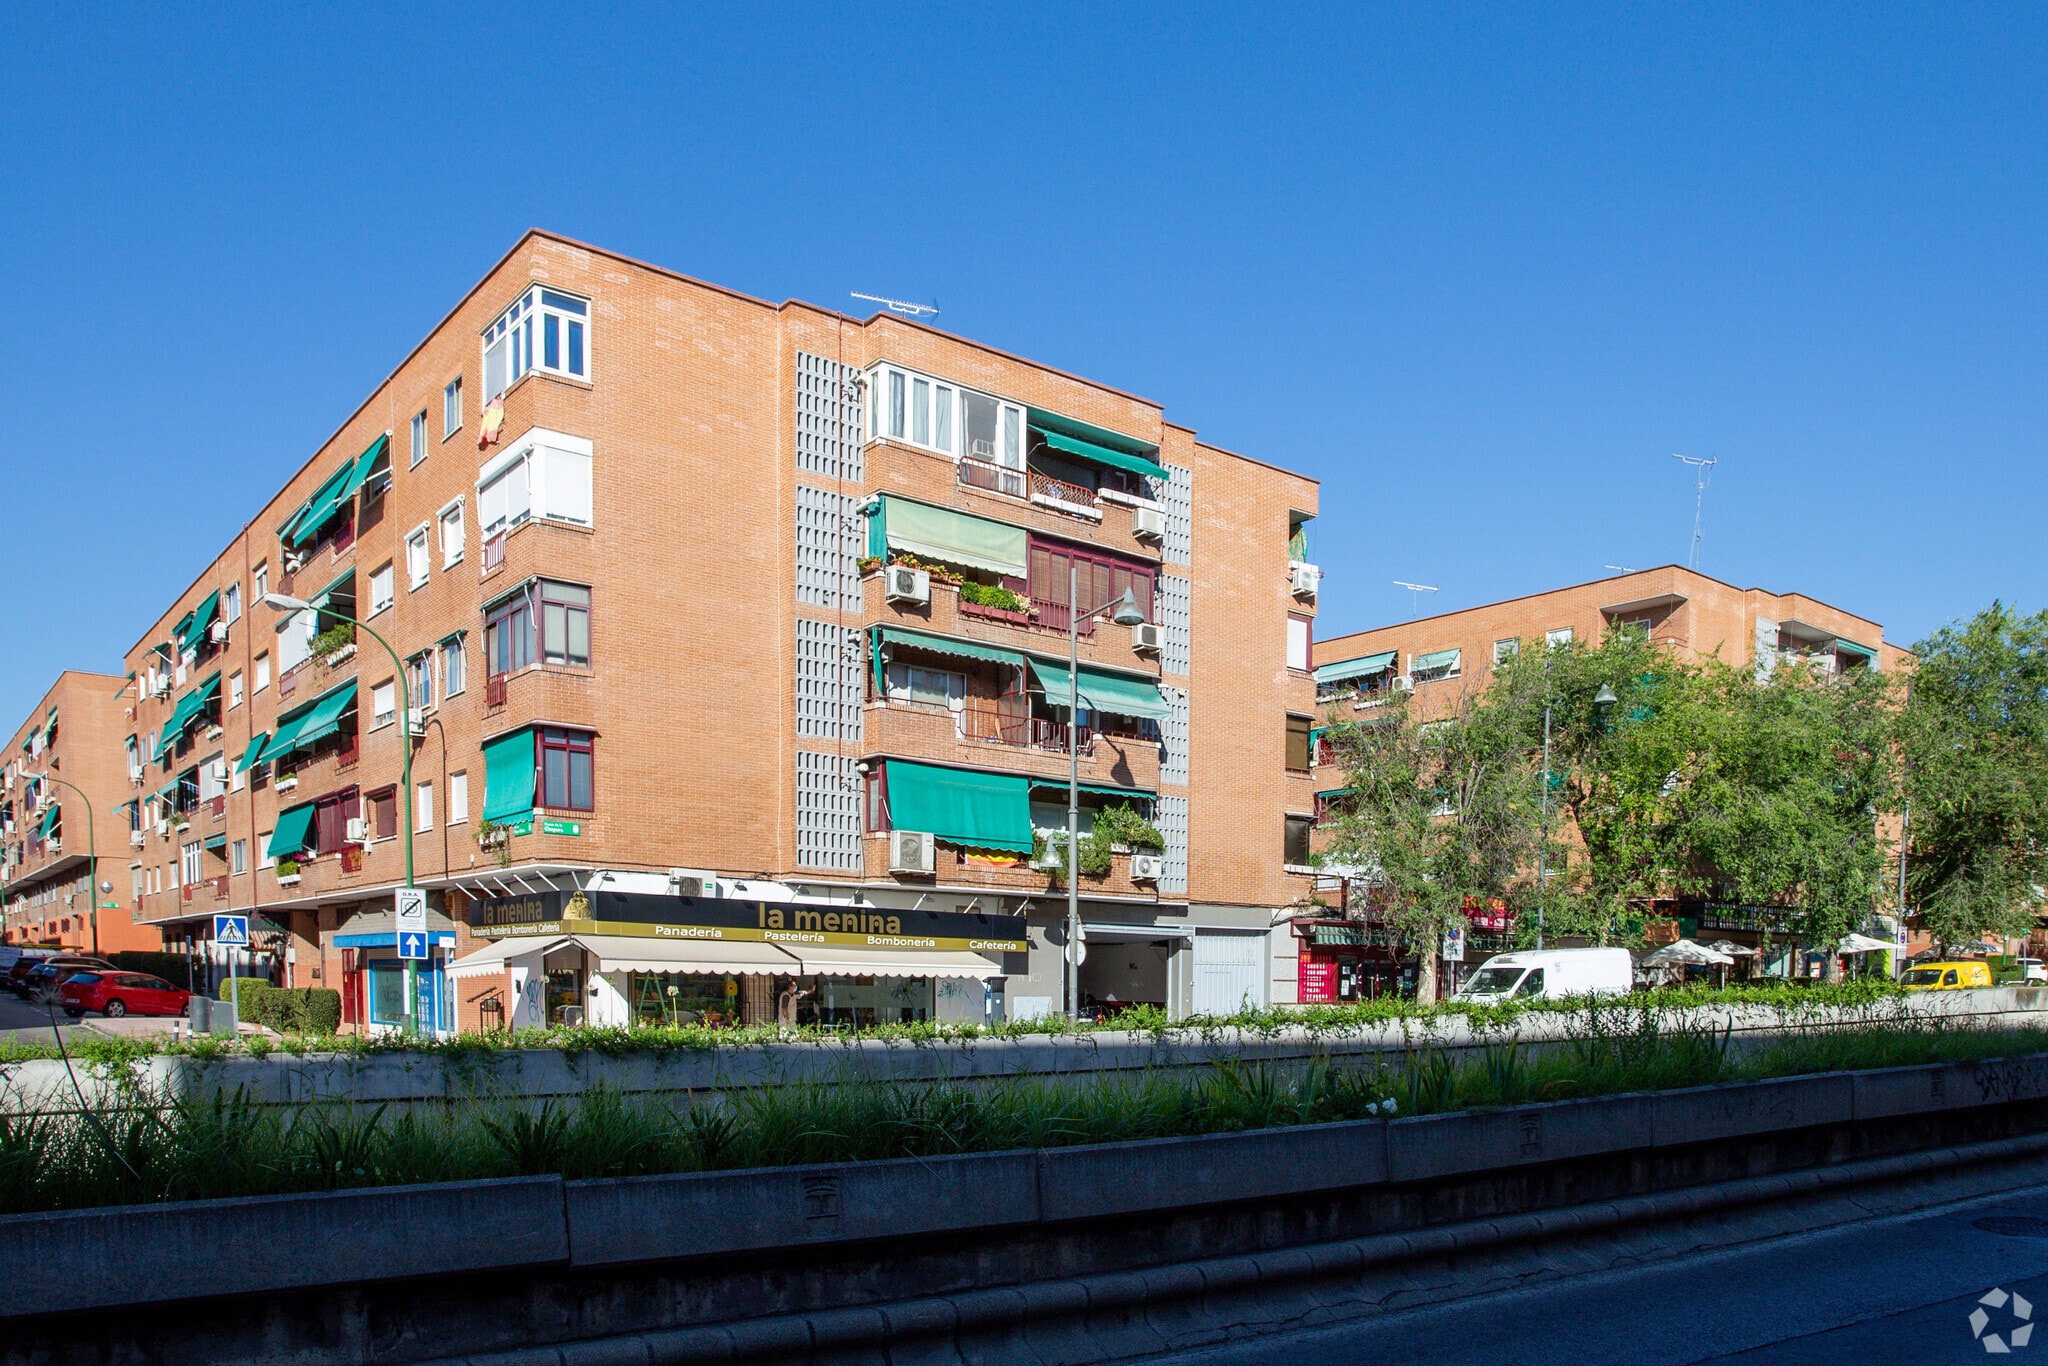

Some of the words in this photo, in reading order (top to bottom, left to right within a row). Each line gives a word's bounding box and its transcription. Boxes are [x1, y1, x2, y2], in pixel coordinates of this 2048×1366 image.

[483, 900, 494, 925] la
[497, 897, 543, 923] menina
[759, 903, 784, 928] la
[794, 909, 901, 935] menina
[538, 922, 560, 933] Cafetería
[655, 925, 723, 938] Panadería
[764, 931, 825, 943] Pastelería
[867, 935, 936, 948] Bombonería
[969, 940, 1017, 951] Cafetería
